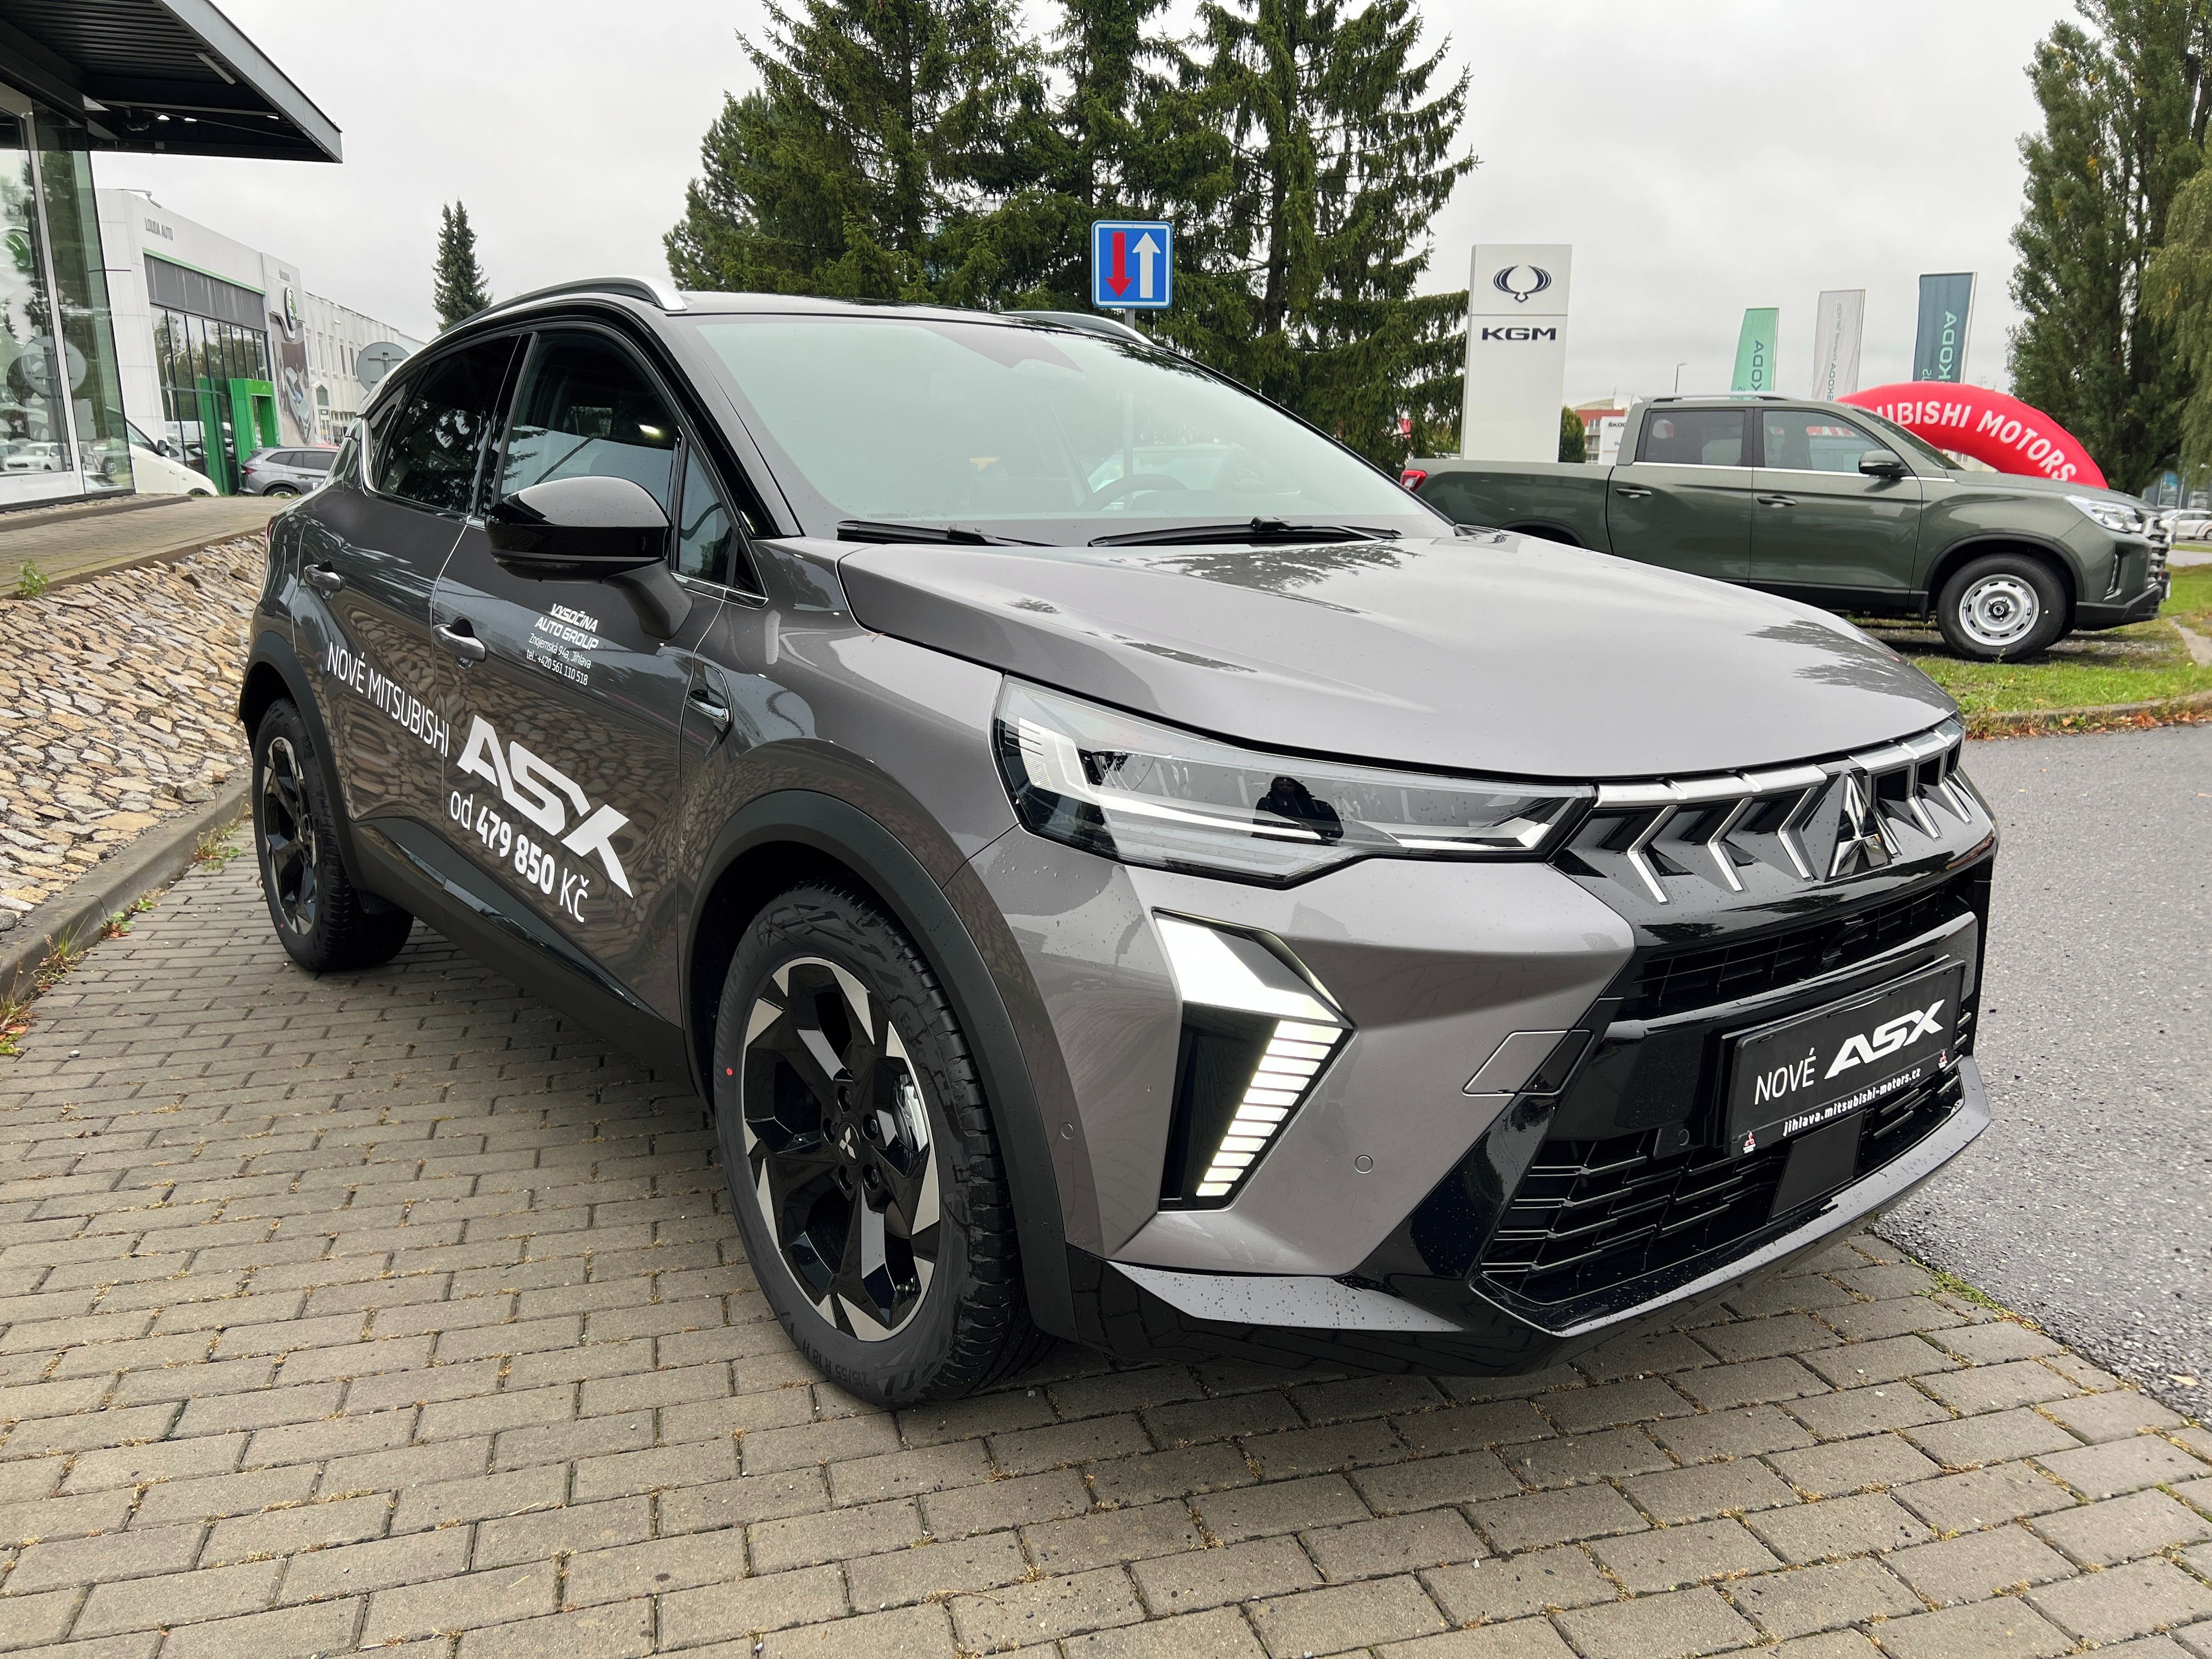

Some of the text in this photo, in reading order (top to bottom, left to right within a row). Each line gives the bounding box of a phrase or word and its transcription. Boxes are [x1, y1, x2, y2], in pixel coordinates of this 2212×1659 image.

[161, 224, 173, 241] AUTO
[1482, 328, 1556, 340] KGM
[1876, 401, 2078, 482] UBISHI MOTORS
[534, 616, 600, 651] AUTO GROUP
[550, 603, 599, 633] VYSOČINA
[528, 633, 592, 669] Znojemská 94a, Jihlava
[537, 655, 552, 669] +420
[551, 659, 563, 675] 561
[563, 665, 575, 680] 110
[575, 670, 589, 686] 518
[327, 641, 450, 758] NOVÉ MITSUBISHI
[457, 714, 634, 899] ASX
[450, 791, 590, 923] od 479 850 Kč
[1754, 998, 1945, 1105] NOVÉ ASX
[1782, 1068, 1921, 1137] jihlava.mitsubishi-motors.cz
[803, 1339, 870, 1387] 215/55 R 18 H
